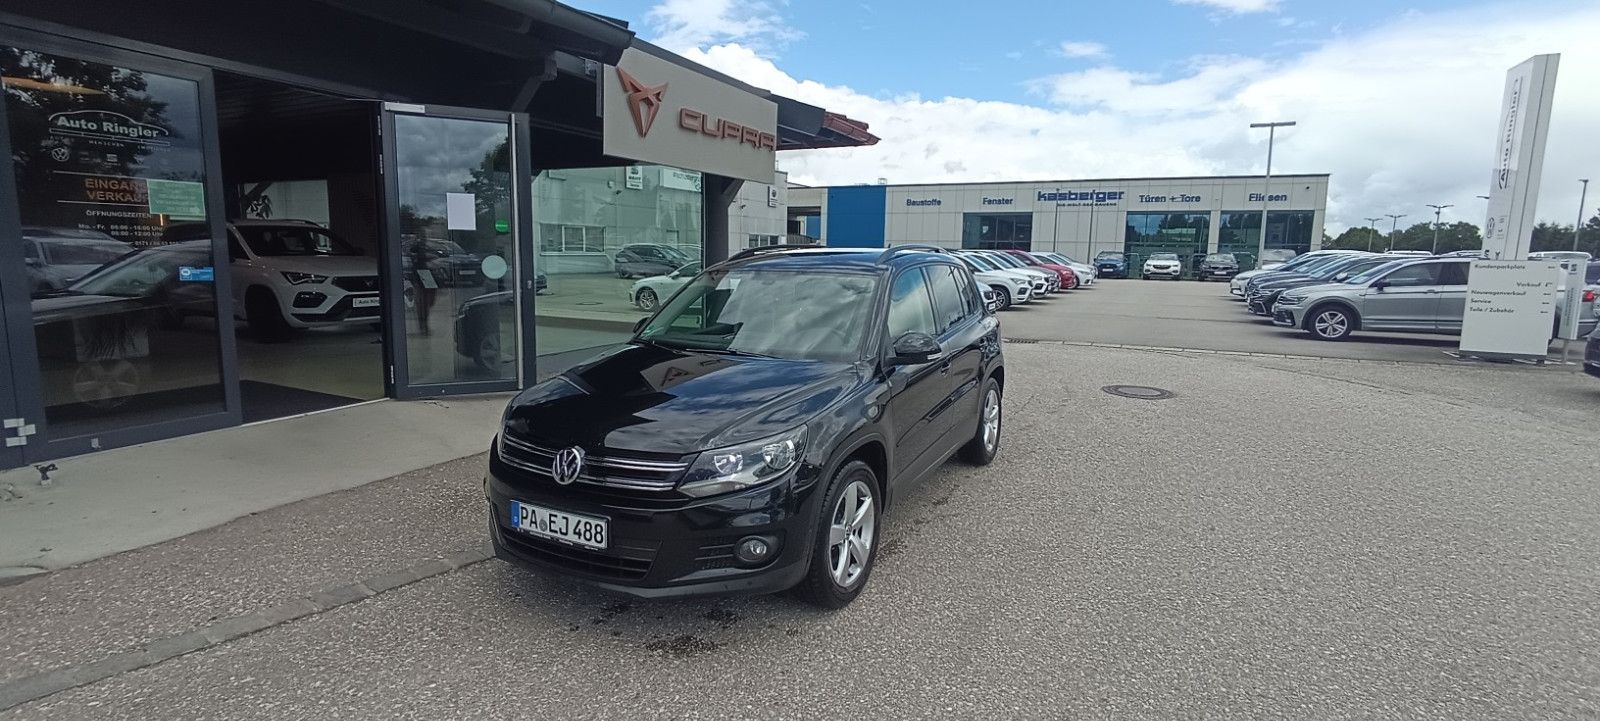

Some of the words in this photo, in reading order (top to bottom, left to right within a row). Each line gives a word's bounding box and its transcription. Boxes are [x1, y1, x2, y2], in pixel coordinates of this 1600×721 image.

[57, 116, 98, 131] Auto
[102, 121, 160, 138] Ringler
[680, 107, 776, 152] CUPRA
[906, 198, 942, 206] Baustoffe
[982, 197, 1014, 205] Fenster
[1139, 194, 1167, 203] Türen
[1179, 193, 1201, 203] Tore
[86, 209, 151, 218] ÖFFNUNGSZEITEN
[520, 506, 538, 529] PA
[548, 513, 569, 537] EJ
[573, 519, 604, 544] 488
